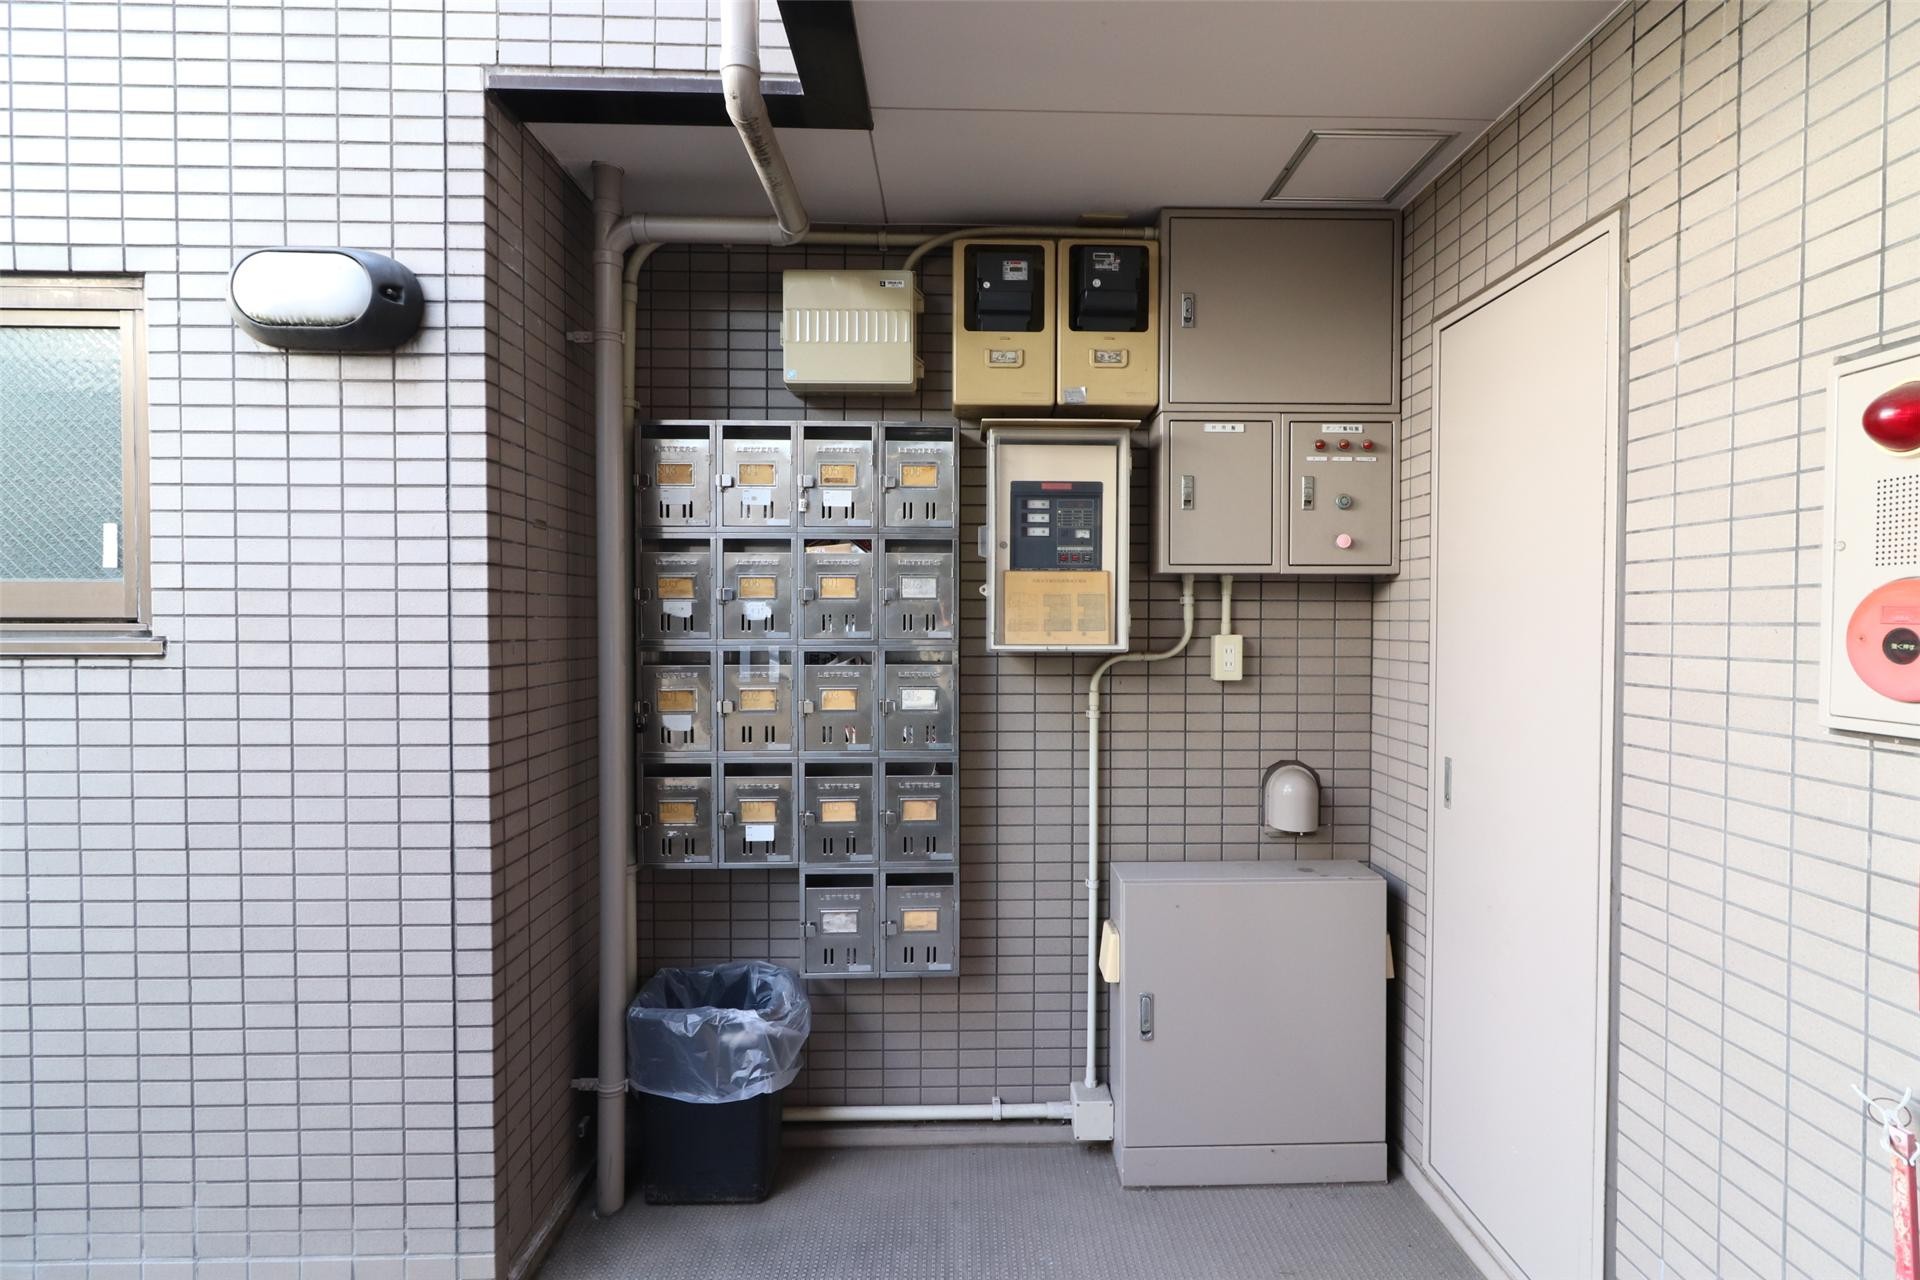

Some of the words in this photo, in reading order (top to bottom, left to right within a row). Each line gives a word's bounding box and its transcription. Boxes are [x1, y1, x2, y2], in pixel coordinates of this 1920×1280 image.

[654, 446, 697, 454] LETTERS
[736, 446, 779, 454] LETTERS
[817, 446, 860, 454] LETTERS
[898, 447, 942, 455] LETTERS
[656, 558, 697, 566] LETTERS
[736, 558, 779, 566] LETTERS
[817, 558, 860, 566] LETTERS
[817, 670, 860, 678] LETTERS
[818, 782, 860, 790] LETTERS
[898, 781, 941, 789] LETTERS
